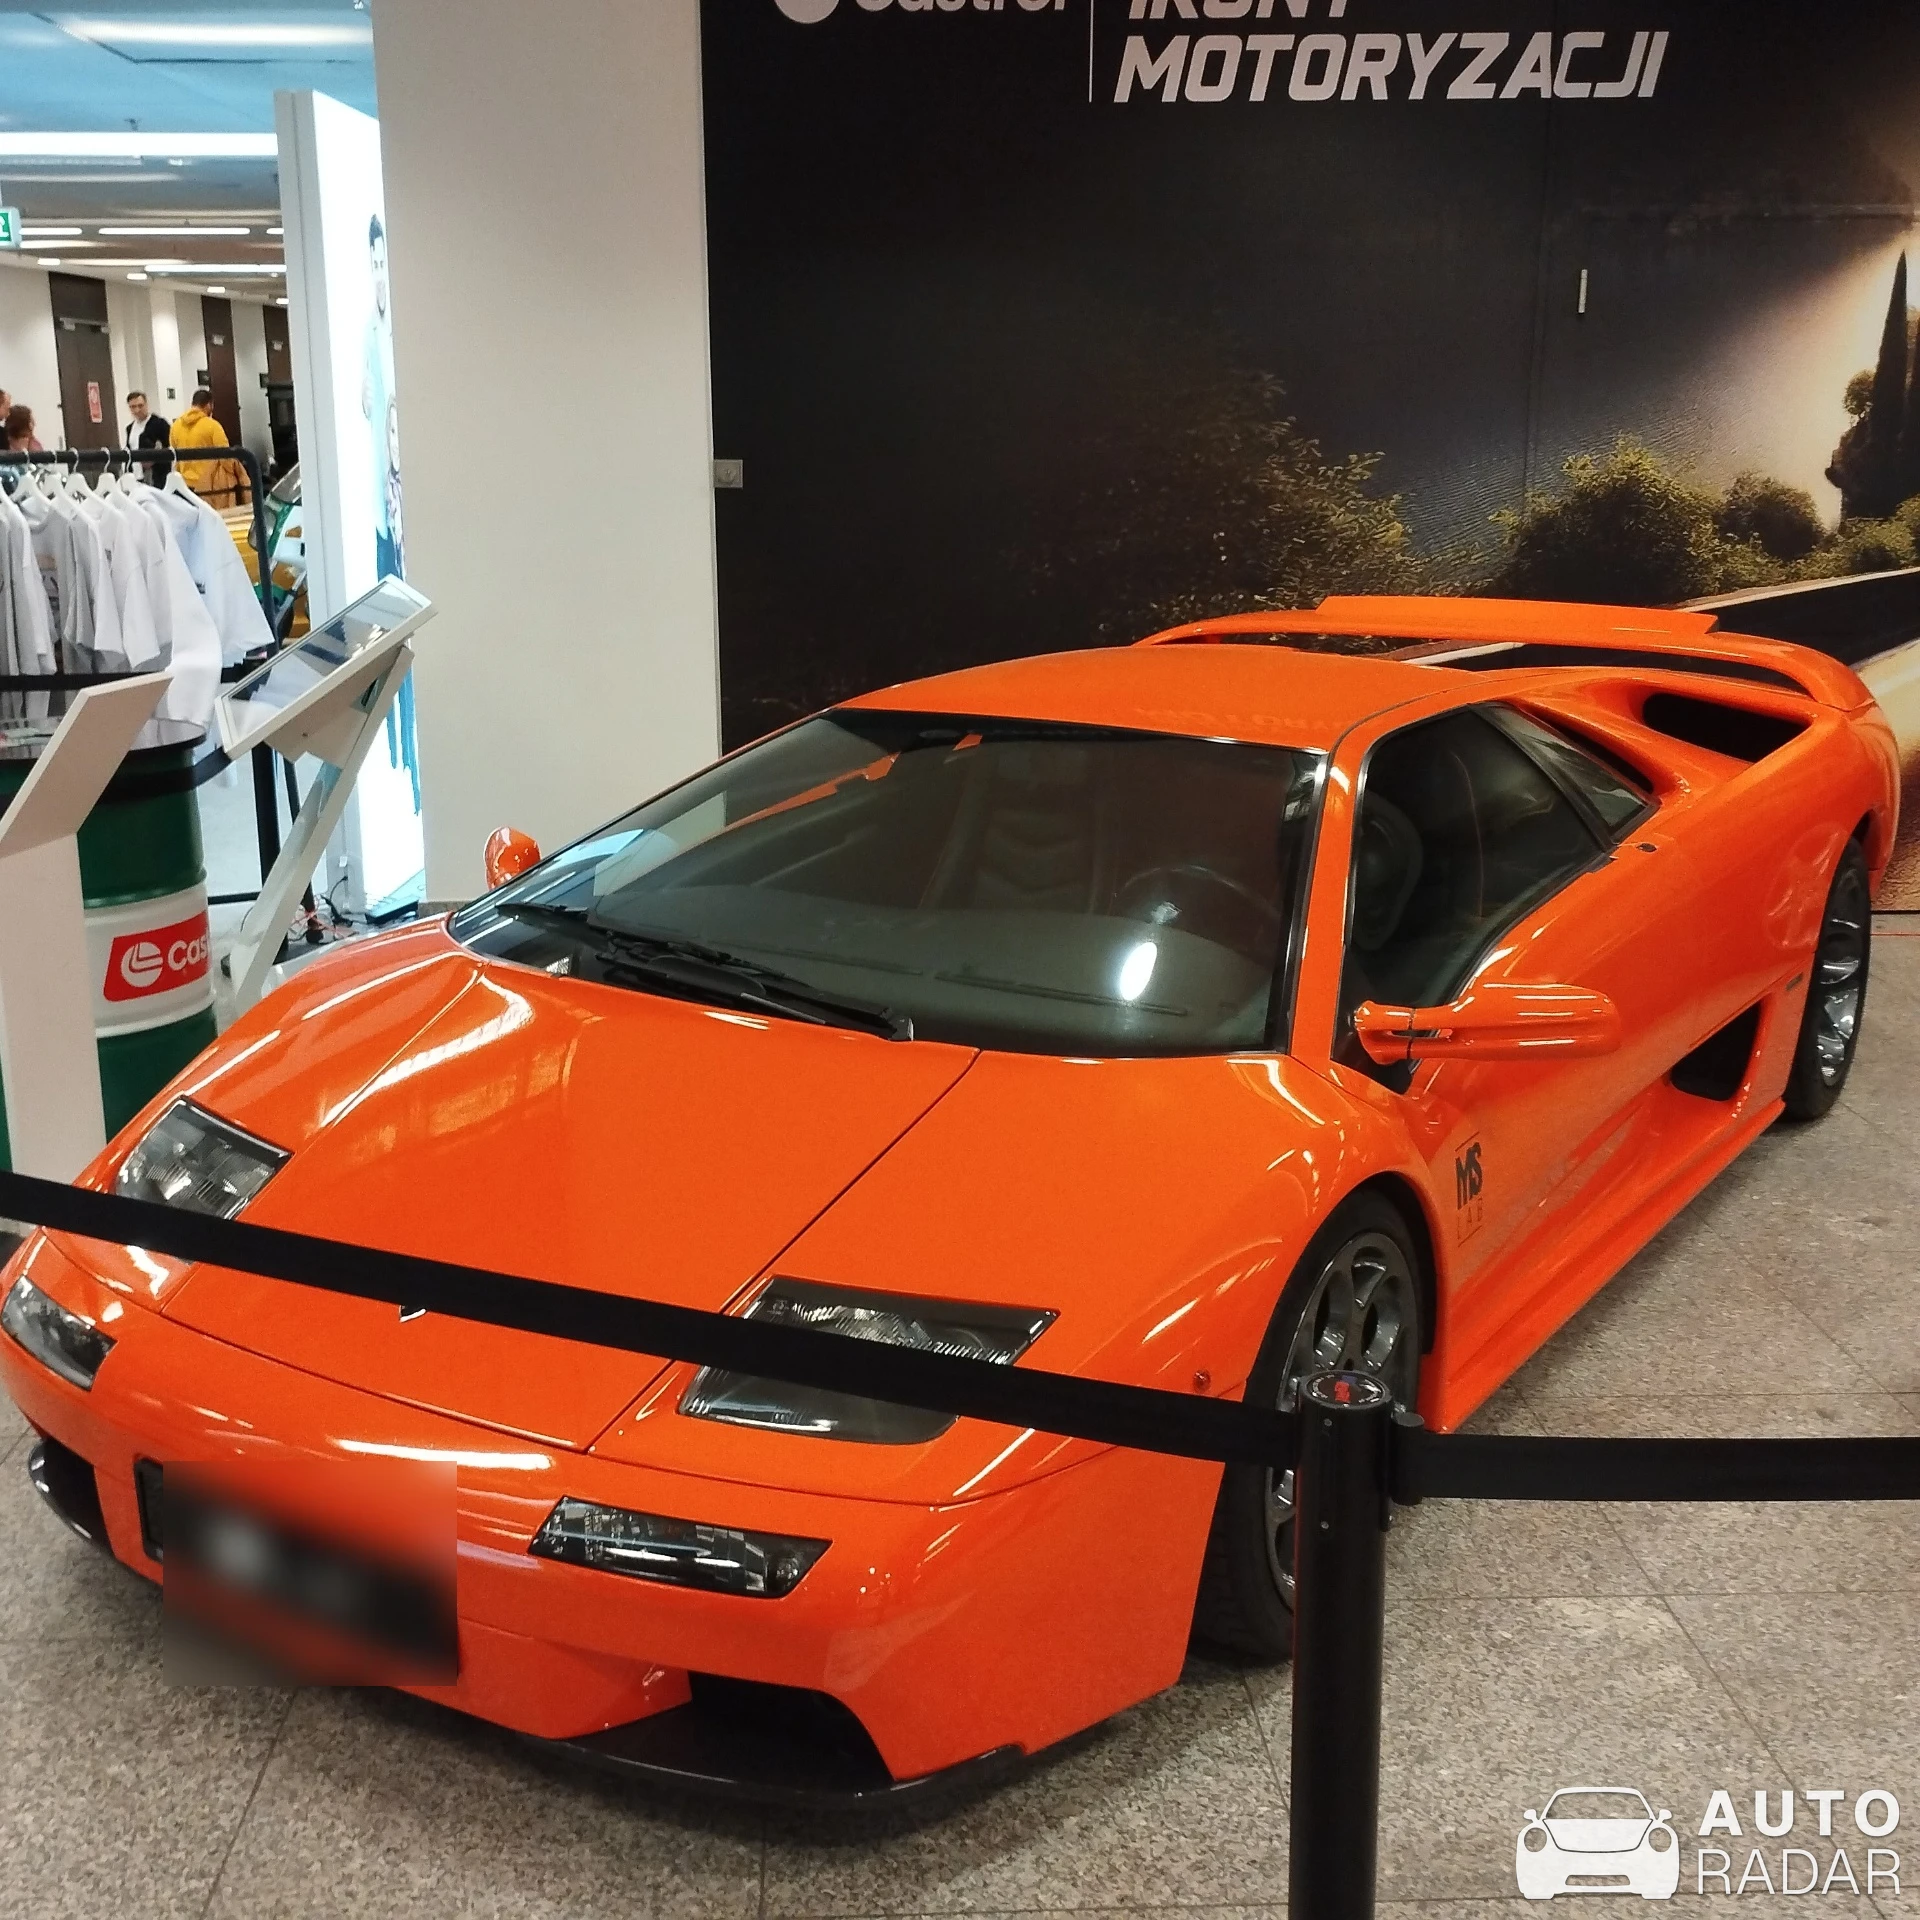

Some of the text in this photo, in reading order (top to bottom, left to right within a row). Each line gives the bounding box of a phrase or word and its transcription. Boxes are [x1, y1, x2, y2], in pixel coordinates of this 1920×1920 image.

[1114, 31, 1670, 102] MOTORYZACJI
[167, 929, 209, 971] Cas
[1455, 1142, 1483, 1210] MS
